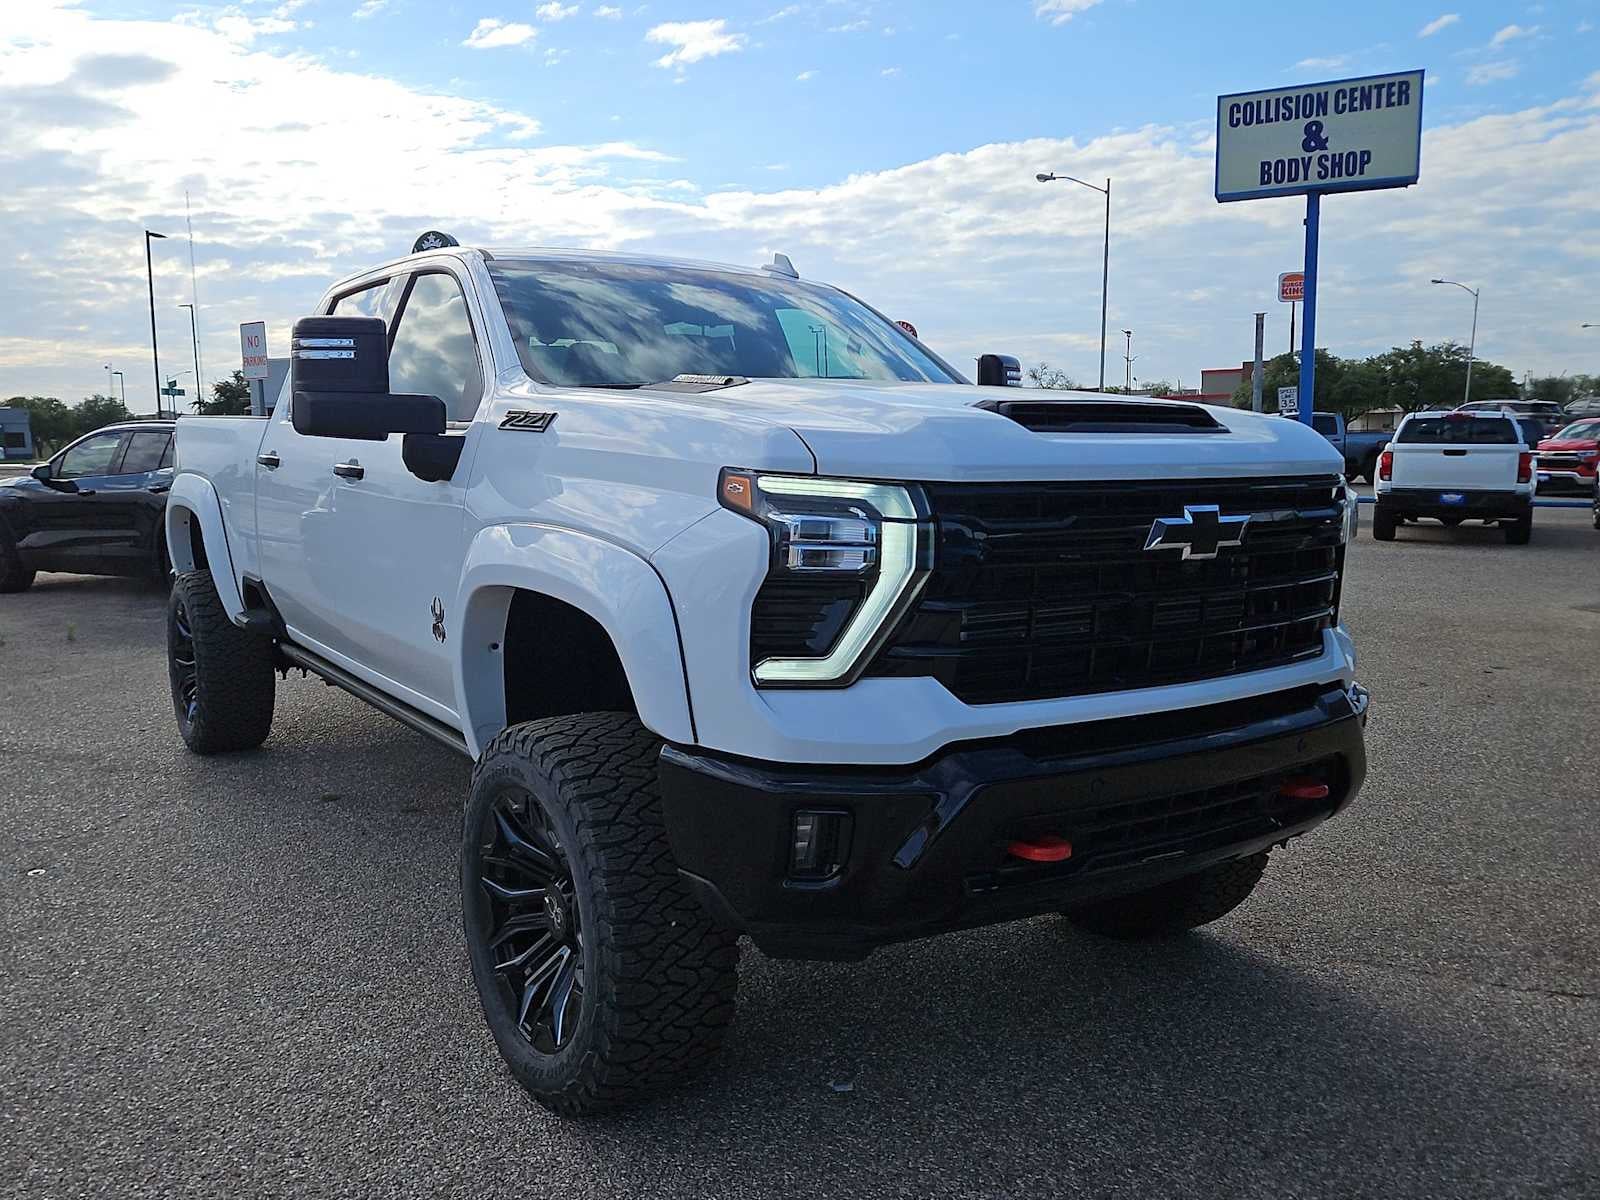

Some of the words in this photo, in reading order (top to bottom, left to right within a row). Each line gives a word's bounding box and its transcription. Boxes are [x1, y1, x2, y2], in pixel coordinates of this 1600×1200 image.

[1229, 91, 1328, 128] COLLISION
[1334, 80, 1410, 115] CENTER
[1301, 120, 1328, 153] &
[1259, 156, 1313, 185] BODY
[1317, 149, 1372, 180] SHOP
[247, 335, 260, 348] NO
[243, 355, 267, 367] PARKING
[1281, 400, 1296, 408] 35
